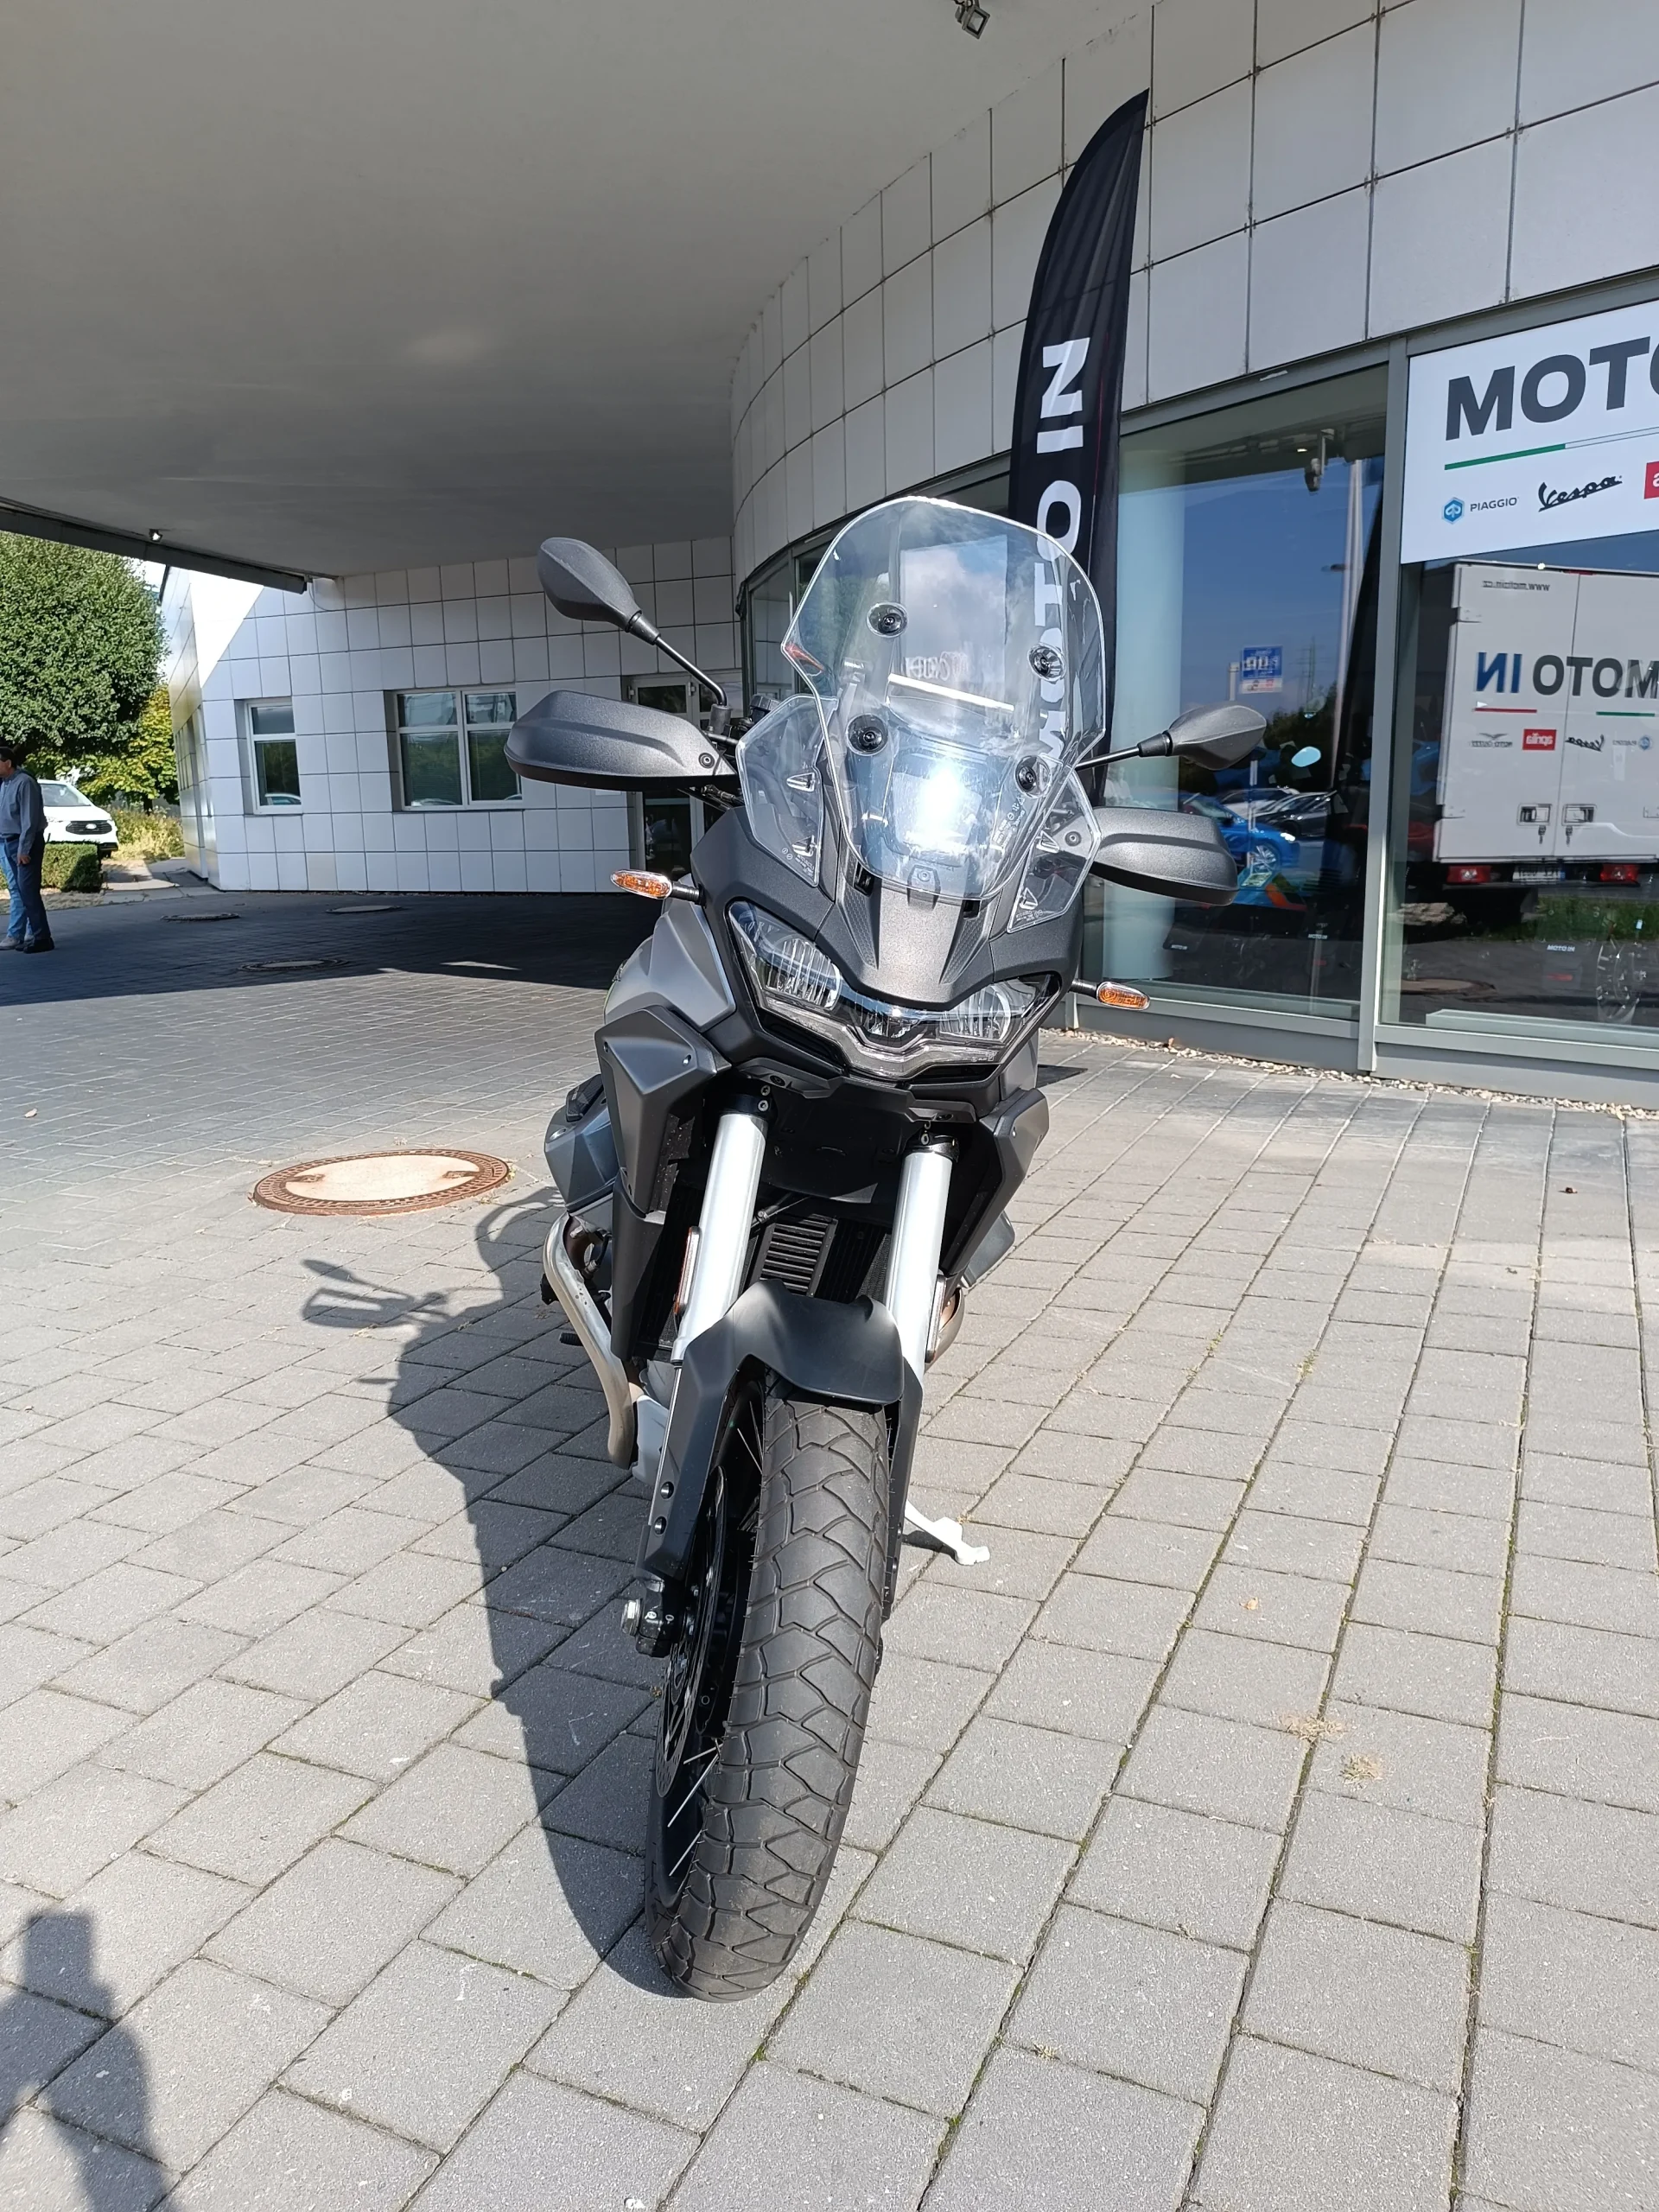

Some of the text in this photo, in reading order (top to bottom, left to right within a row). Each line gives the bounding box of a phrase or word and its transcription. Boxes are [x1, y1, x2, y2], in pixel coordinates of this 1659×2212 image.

[1037, 337, 1090, 456] IN
[1446, 336, 1659, 441] MOT
[1470, 497, 1518, 512] PIAGGIO
[1538, 475, 1623, 512] Vespa
